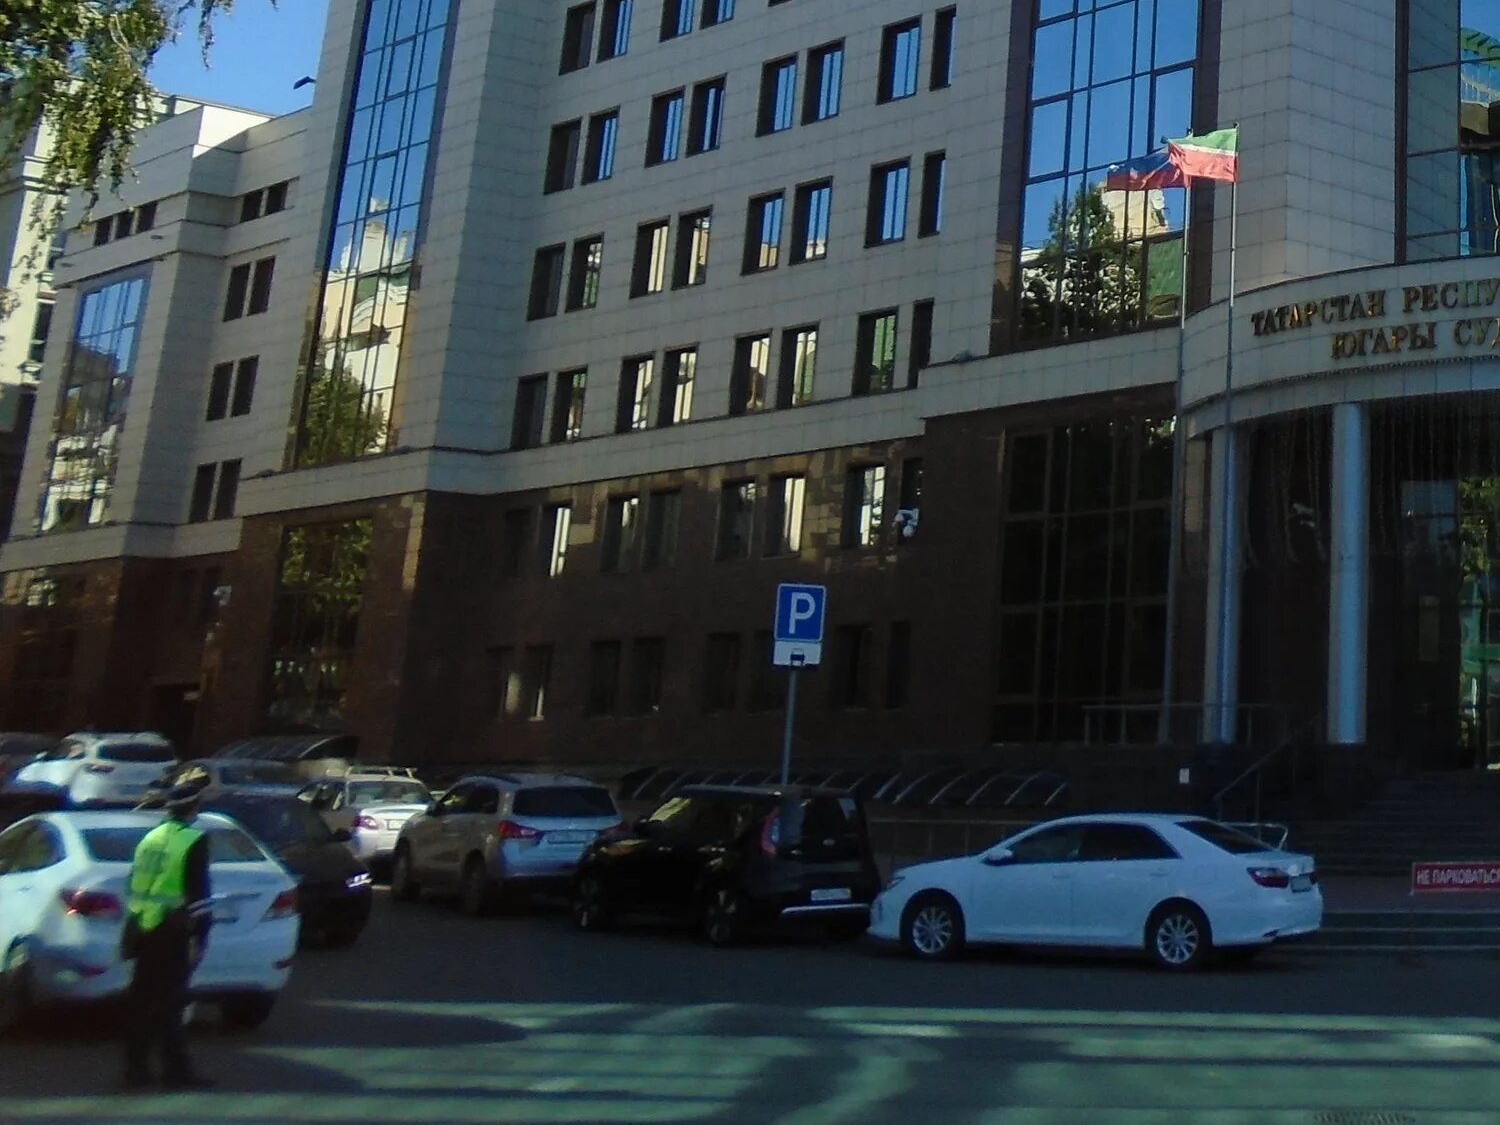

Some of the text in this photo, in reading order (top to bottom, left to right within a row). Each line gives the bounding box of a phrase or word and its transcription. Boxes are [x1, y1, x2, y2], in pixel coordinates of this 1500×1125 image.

[1251, 289, 1386, 336] ТАТАРСТАН
[1330, 321, 1438, 359] ЮГАРЫ
[788, 591, 816, 635] P
[1416, 869, 1430, 885] НЕ
